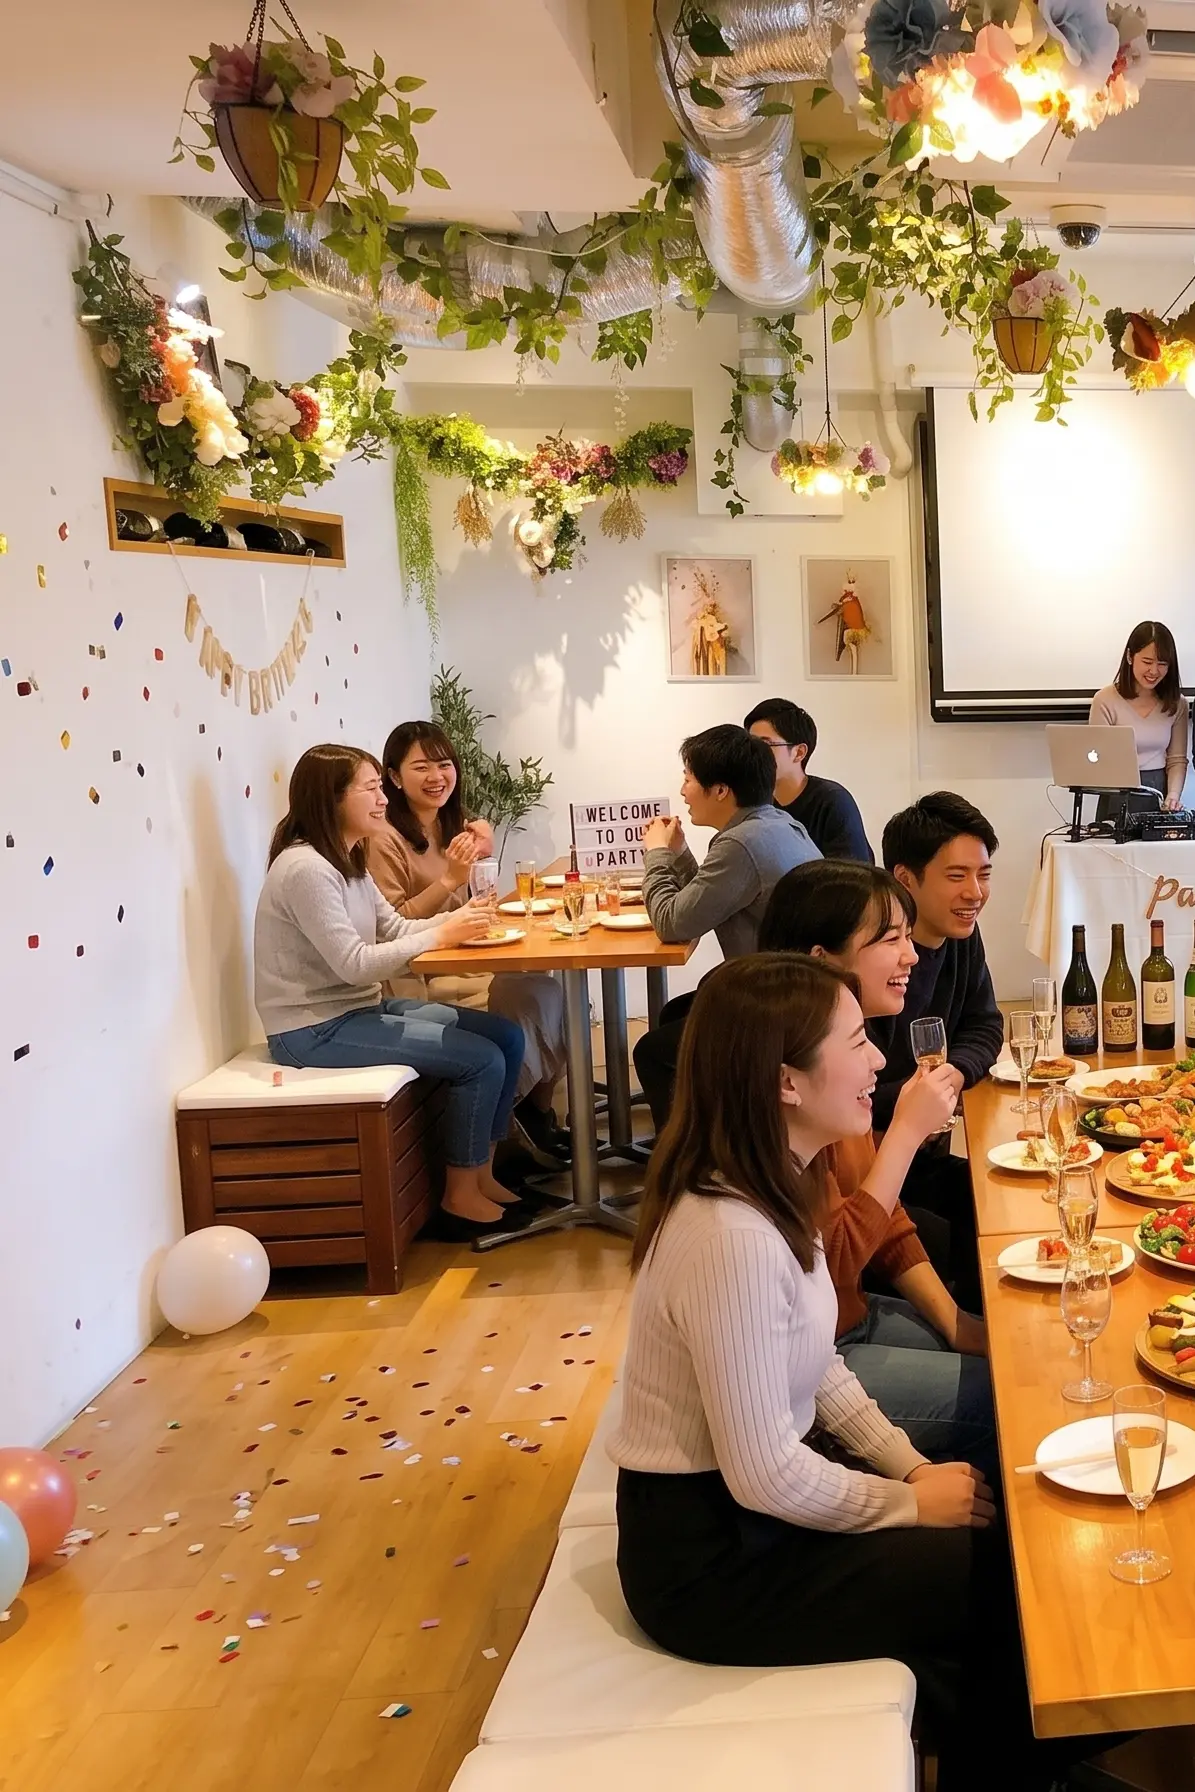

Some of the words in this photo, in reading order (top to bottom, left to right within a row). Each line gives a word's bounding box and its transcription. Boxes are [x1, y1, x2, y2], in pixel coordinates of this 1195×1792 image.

[586, 803, 661, 823] WELCOME
[596, 829, 615, 844] TO
[624, 826, 644, 842] OU
